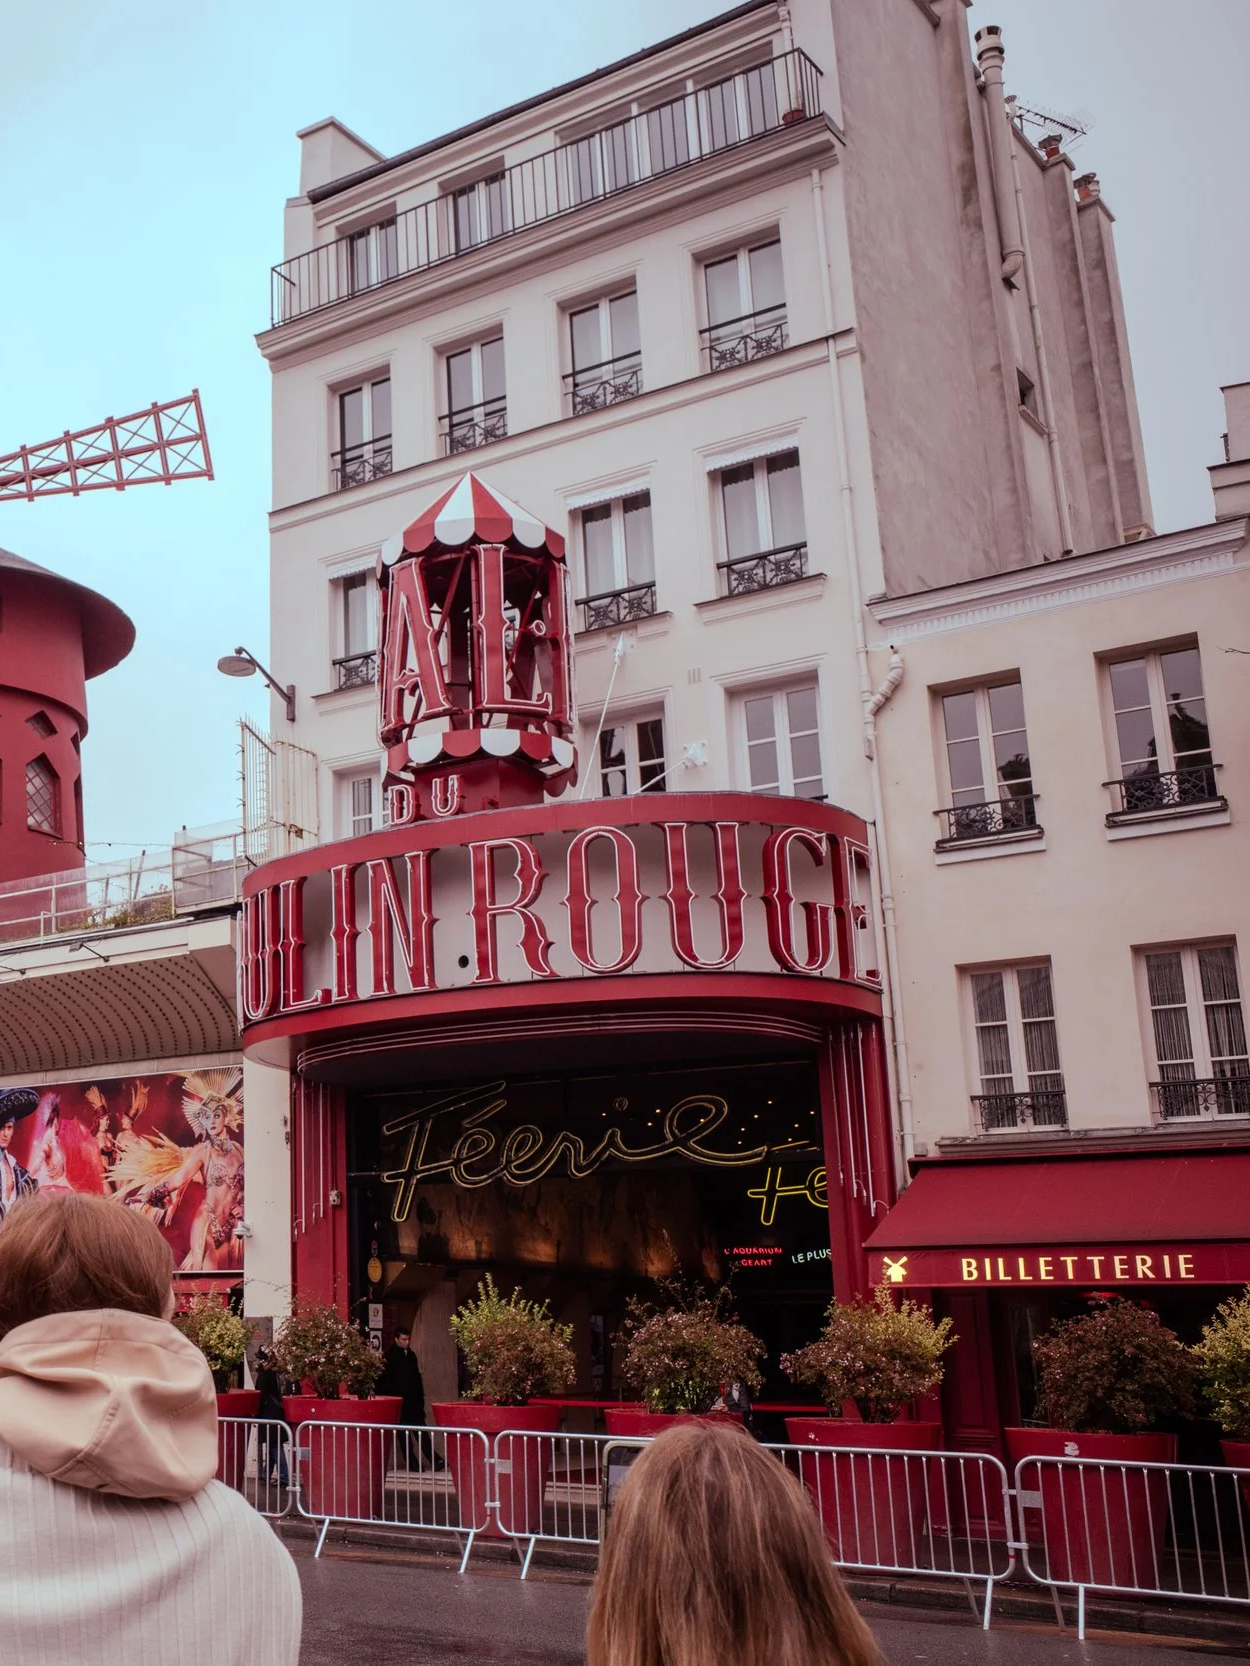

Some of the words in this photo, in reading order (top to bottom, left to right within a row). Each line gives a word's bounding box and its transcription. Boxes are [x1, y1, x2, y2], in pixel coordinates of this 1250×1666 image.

[388, 774, 465, 825] DU
[466, 821, 883, 994] ROUGE
[381, 1080, 768, 1223] Féerie
[792, 1253, 805, 1264] LE
[961, 1254, 1195, 1281] BILLETTERIE
